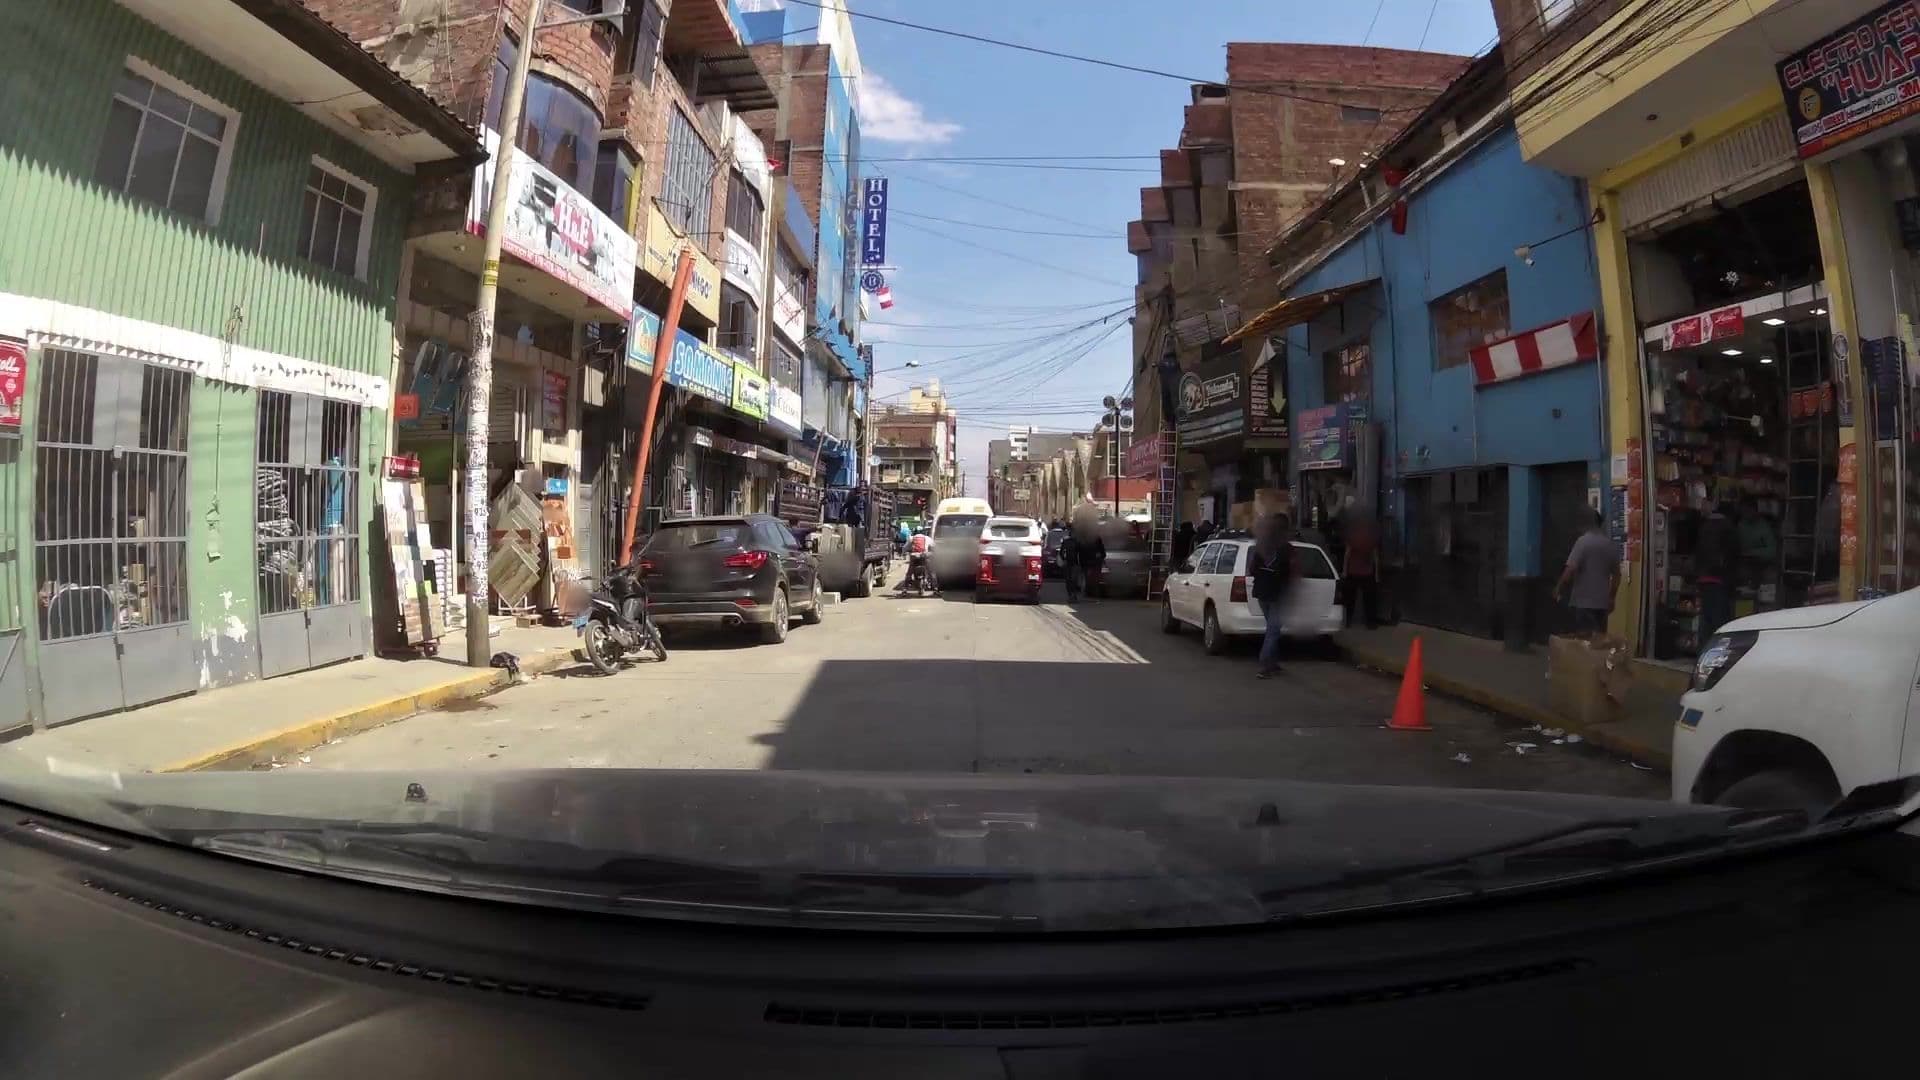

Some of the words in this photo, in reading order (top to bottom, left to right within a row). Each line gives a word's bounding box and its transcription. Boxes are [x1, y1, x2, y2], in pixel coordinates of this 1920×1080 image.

[1783, 24, 1874, 88] ELECTRO
[868, 180, 883, 253] HOTEL
[689, 381, 706, 396] CASA
